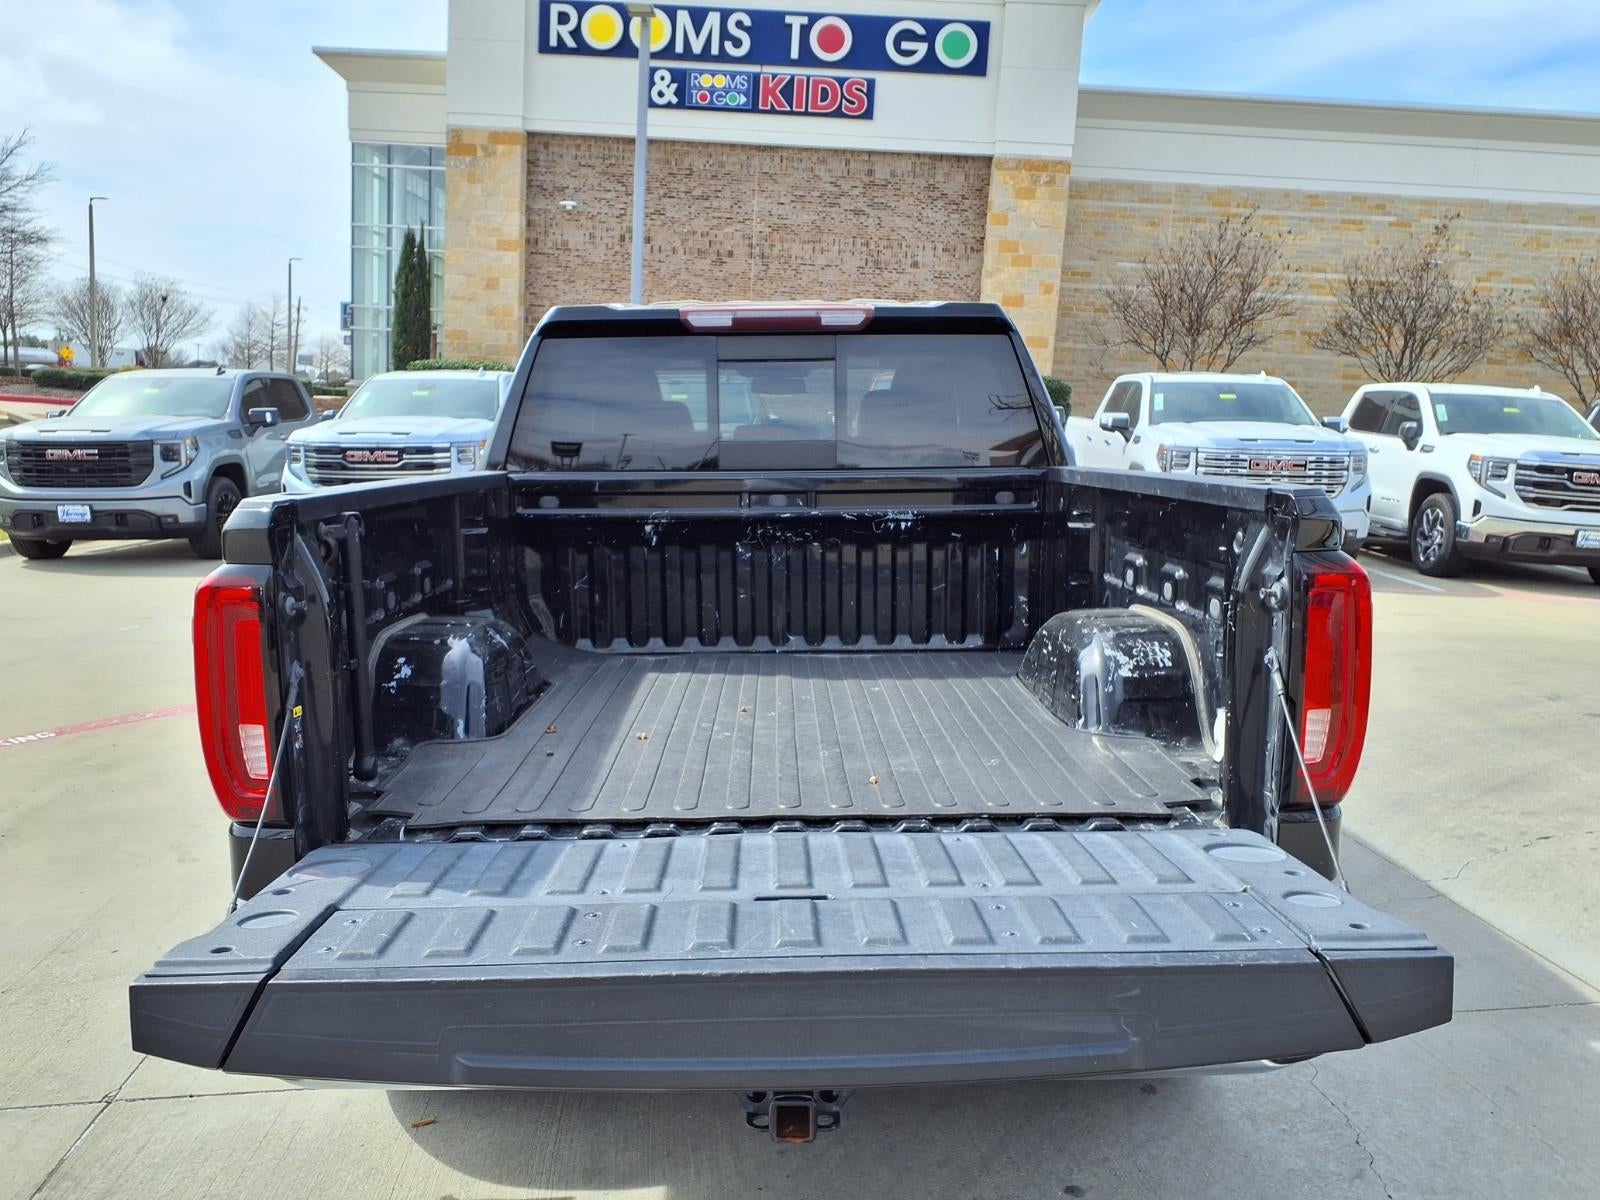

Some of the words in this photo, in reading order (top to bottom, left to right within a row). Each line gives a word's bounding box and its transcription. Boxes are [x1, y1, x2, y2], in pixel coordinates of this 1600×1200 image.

[549, 2, 752, 58] ROOMS
[785, 15, 853, 62] TO
[885, 20, 978, 68] GO
[690, 72, 748, 89] ROOMS
[650, 68, 678, 105] &
[759, 73, 868, 117] KIDS
[691, 90, 710, 104] TO
[713, 91, 740, 106] GO
[45, 449, 99, 460] GMC
[346, 450, 398, 462] GMC
[1251, 460, 1306, 471] GMC
